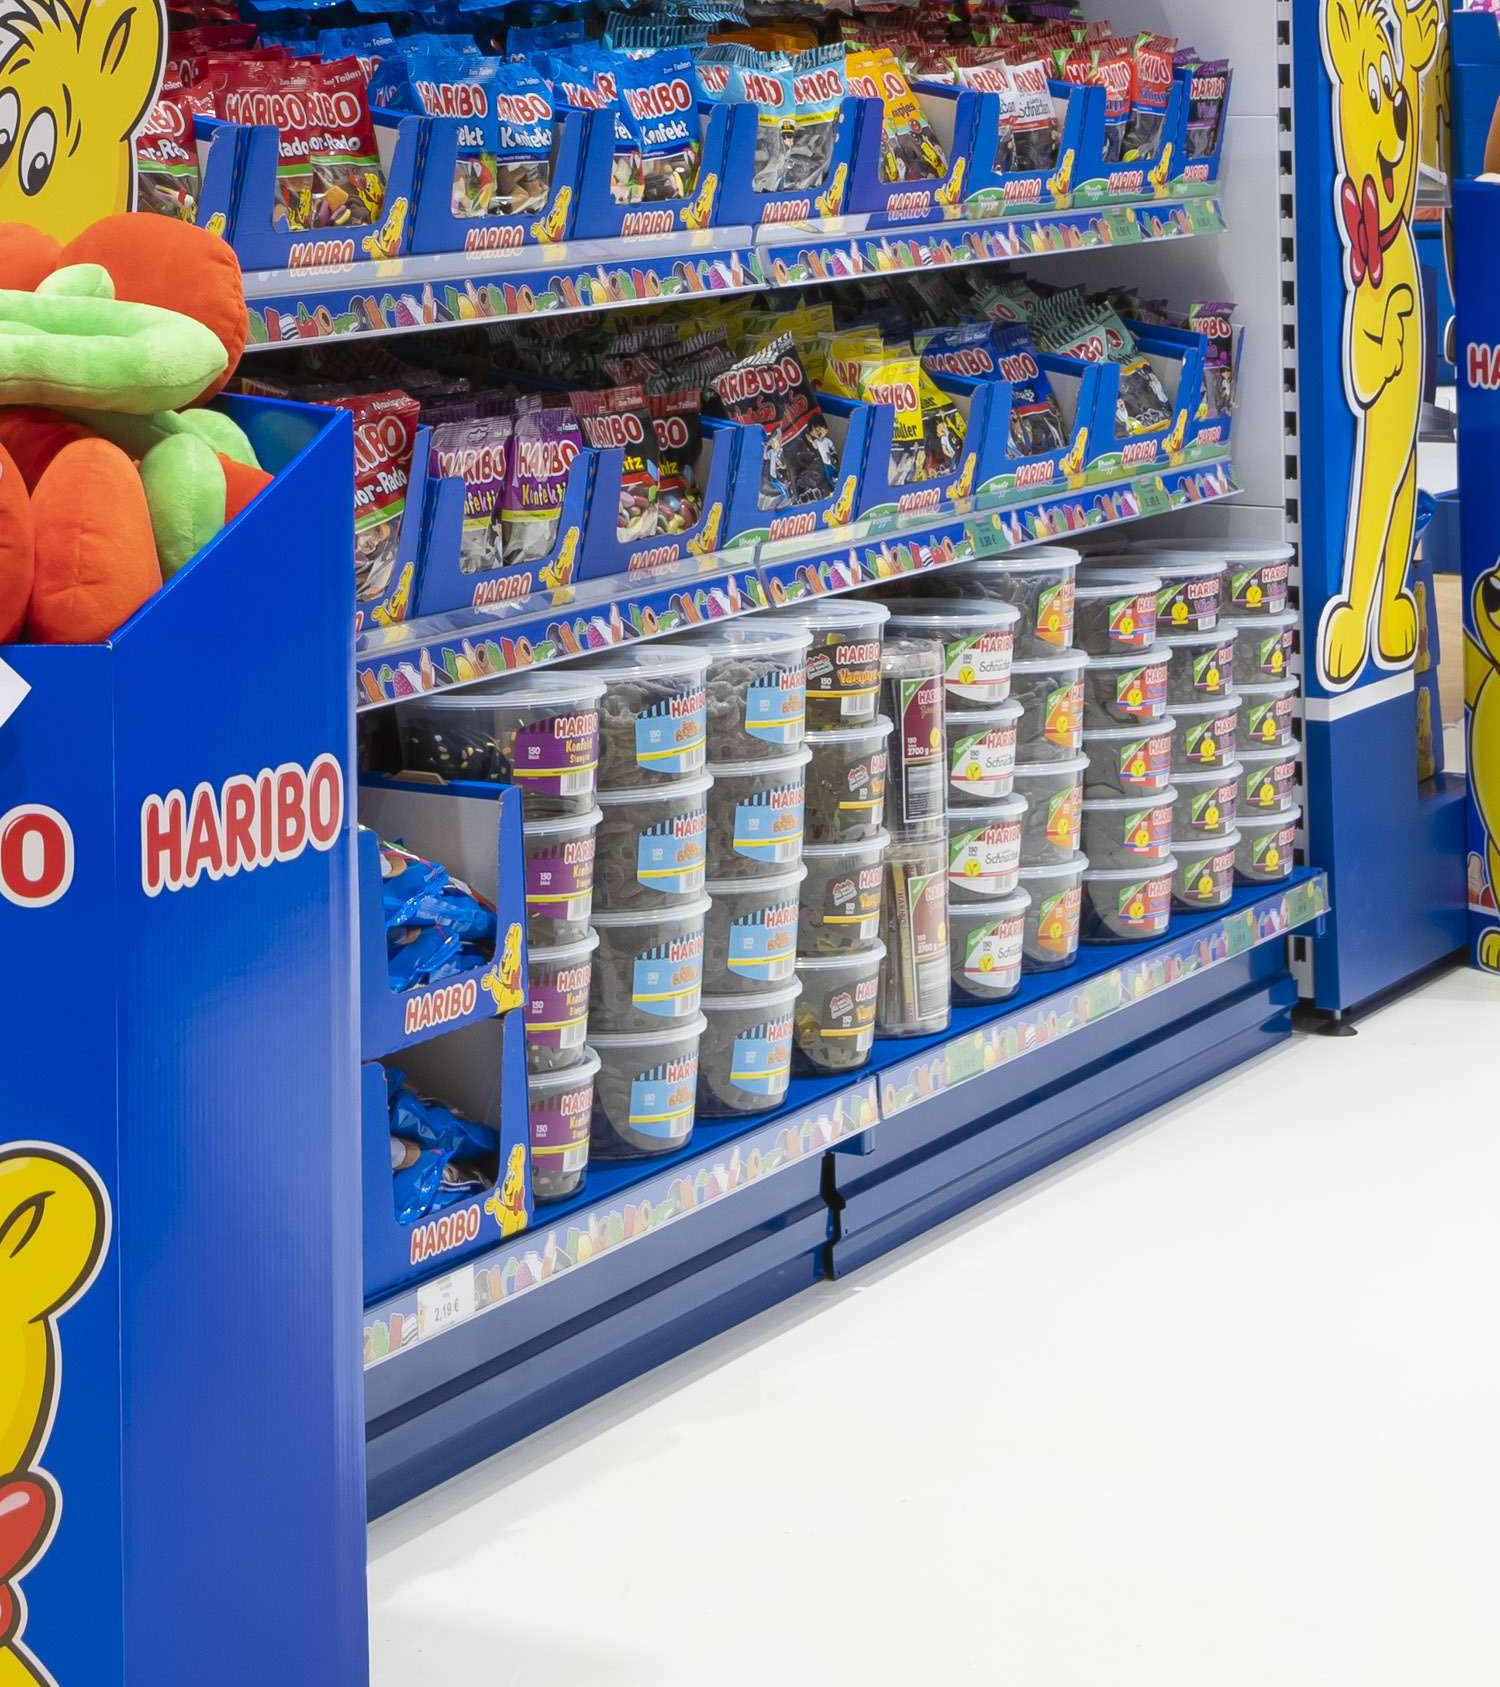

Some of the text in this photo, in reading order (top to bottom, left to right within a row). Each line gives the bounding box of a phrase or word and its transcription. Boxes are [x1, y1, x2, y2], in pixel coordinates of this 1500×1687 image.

[226, 91, 307, 130] HARIBO
[418, 81, 490, 119] HARIBO
[887, 191, 931, 219] HARIBO
[1004, 178, 1041, 202] HARIBO
[466, 227, 524, 258] HARIBO
[622, 211, 675, 241] HARIBO
[289, 240, 354, 274] HARIBO
[1015, 460, 1053, 486] HARIBO
[769, 513, 817, 540] HARIBO
[473, 572, 532, 607] HARIBO
[144, 758, 340, 892] HARIBO
[405, 980, 476, 1035] HARIBO
[410, 1203, 480, 1265] HARIBO
